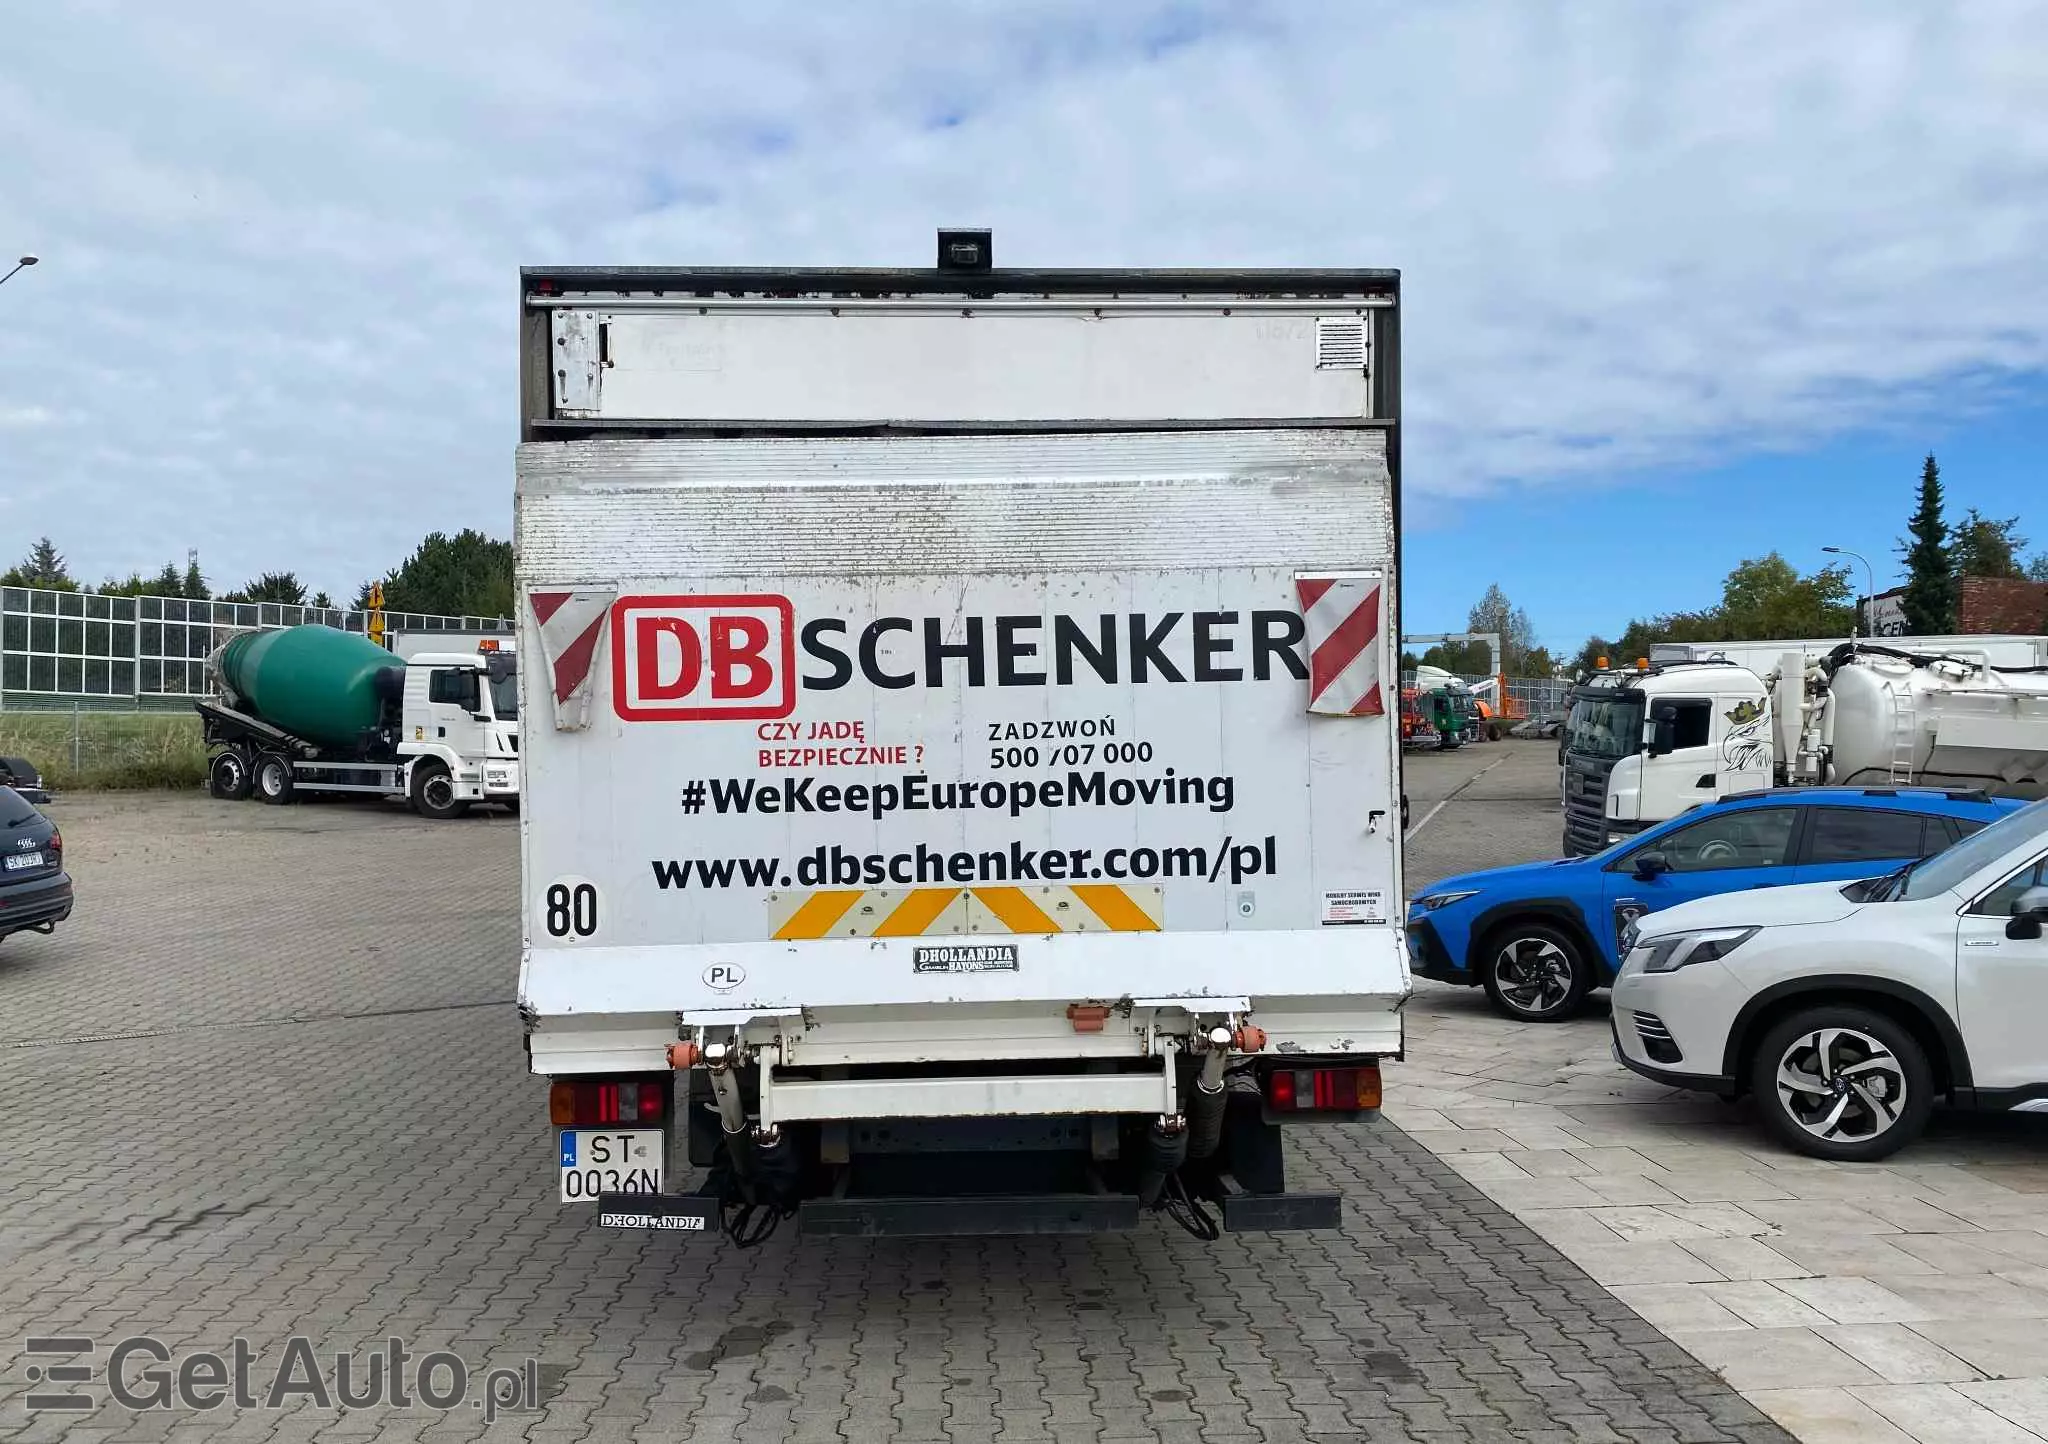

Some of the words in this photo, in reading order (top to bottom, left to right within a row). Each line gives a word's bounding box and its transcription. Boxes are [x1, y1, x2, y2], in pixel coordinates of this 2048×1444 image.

[635, 615, 774, 701] DB
[800, 610, 1311, 690] SCHENKER
[757, 722, 801, 741] CZY
[807, 720, 866, 743] JADĘ
[988, 715, 1116, 741] ZADZWOŃ
[758, 746, 908, 768] BEZPIECZNIE
[990, 747, 1040, 769] 500
[1103, 741, 1154, 764] 000
[681, 767, 1235, 820] #WeKeepEuropeMoving
[651, 835, 1278, 890] www.dbschenker.com/pl
[546, 883, 597, 938] 80
[919, 947, 1014, 963] DHOLLANDIA
[711, 967, 738, 983] PL
[563, 1153, 575, 1162] PL
[591, 1135, 635, 1163] ST
[566, 1168, 659, 1198] 0036N
[602, 1215, 701, 1229] DHOLLANDIA
